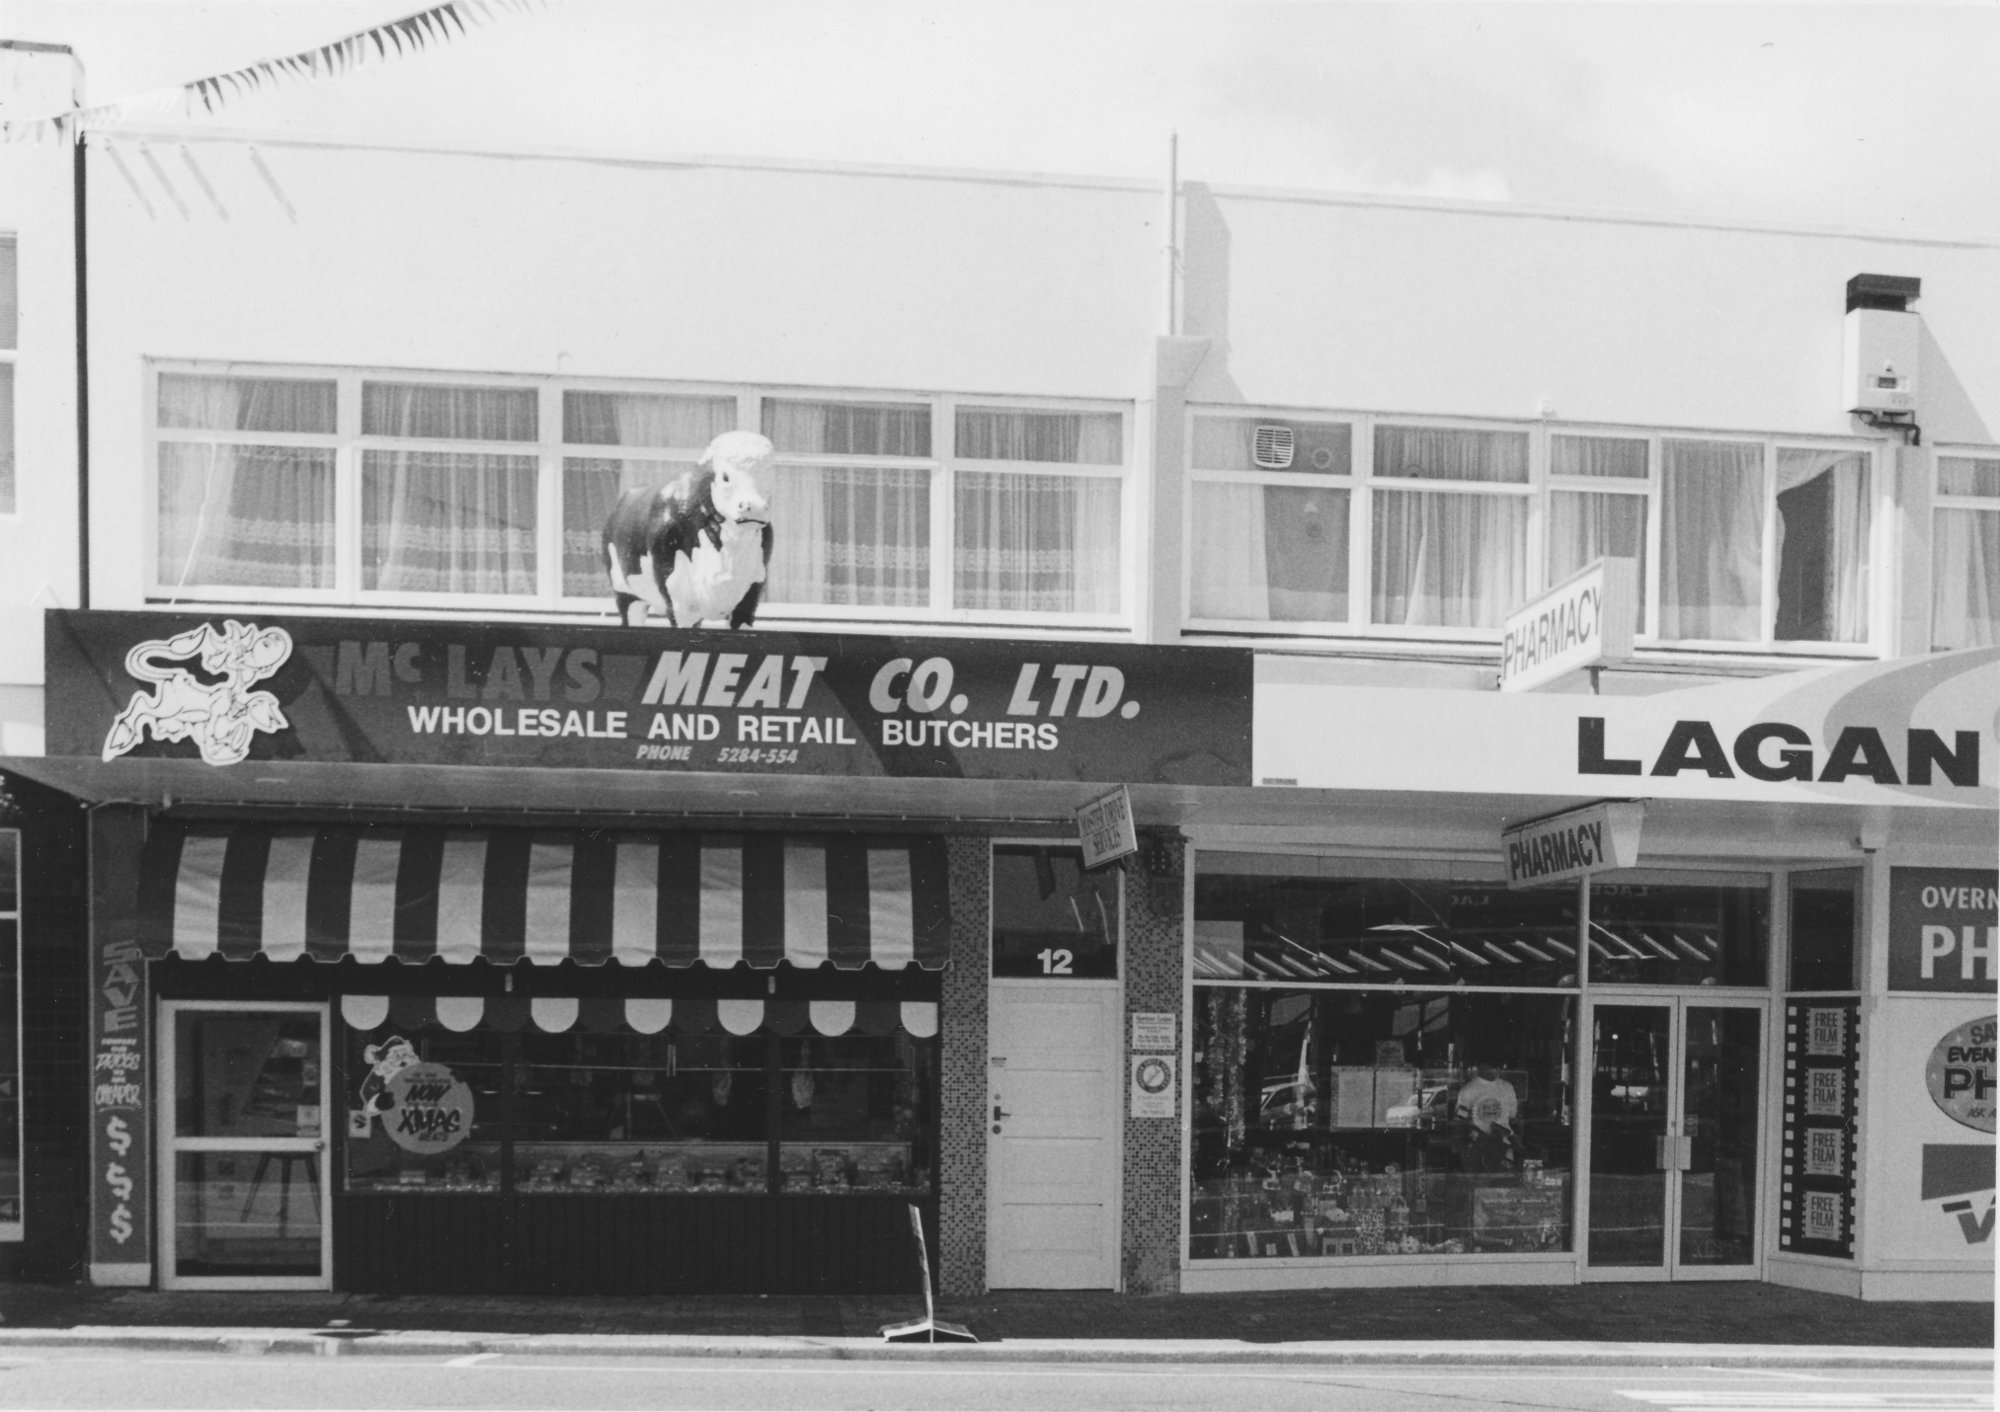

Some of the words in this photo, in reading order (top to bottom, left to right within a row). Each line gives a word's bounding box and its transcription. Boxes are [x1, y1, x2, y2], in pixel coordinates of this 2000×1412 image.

[1504, 586, 1602, 680] PHARMACY
[448, 644, 601, 703] LAYS
[641, 650, 828, 709] MEAT
[869, 657, 968, 715] CO.
[1006, 662, 1140, 719] LTD.
[407, 705, 628, 738] WHOLESALE
[648, 712, 720, 741] AND
[738, 715, 856, 745] RETAIL
[882, 719, 1058, 751] BUTCHERS
[636, 744, 692, 760] PHONE
[717, 747, 799, 763] 5284-554
[1578, 716, 1979, 787] LAGAN
[1510, 821, 1603, 880] PHARMACY
[1037, 948, 1073, 974] 12
[1921, 925, 1998, 979] PH
[103, 940, 143, 1031] SAVE
[1815, 1012, 1838, 1027] FREE
[1814, 1028, 1838, 1042] FILM
[1814, 1073, 1837, 1087] FREE
[1813, 1088, 1837, 1103] FILM
[397, 1104, 461, 1135] XMAS
[1813, 1133, 1836, 1147] FREE
[1812, 1148, 1836, 1162] FILM
[1812, 1196, 1834, 1211] FREE
[1811, 1212, 1834, 1227] FILM
